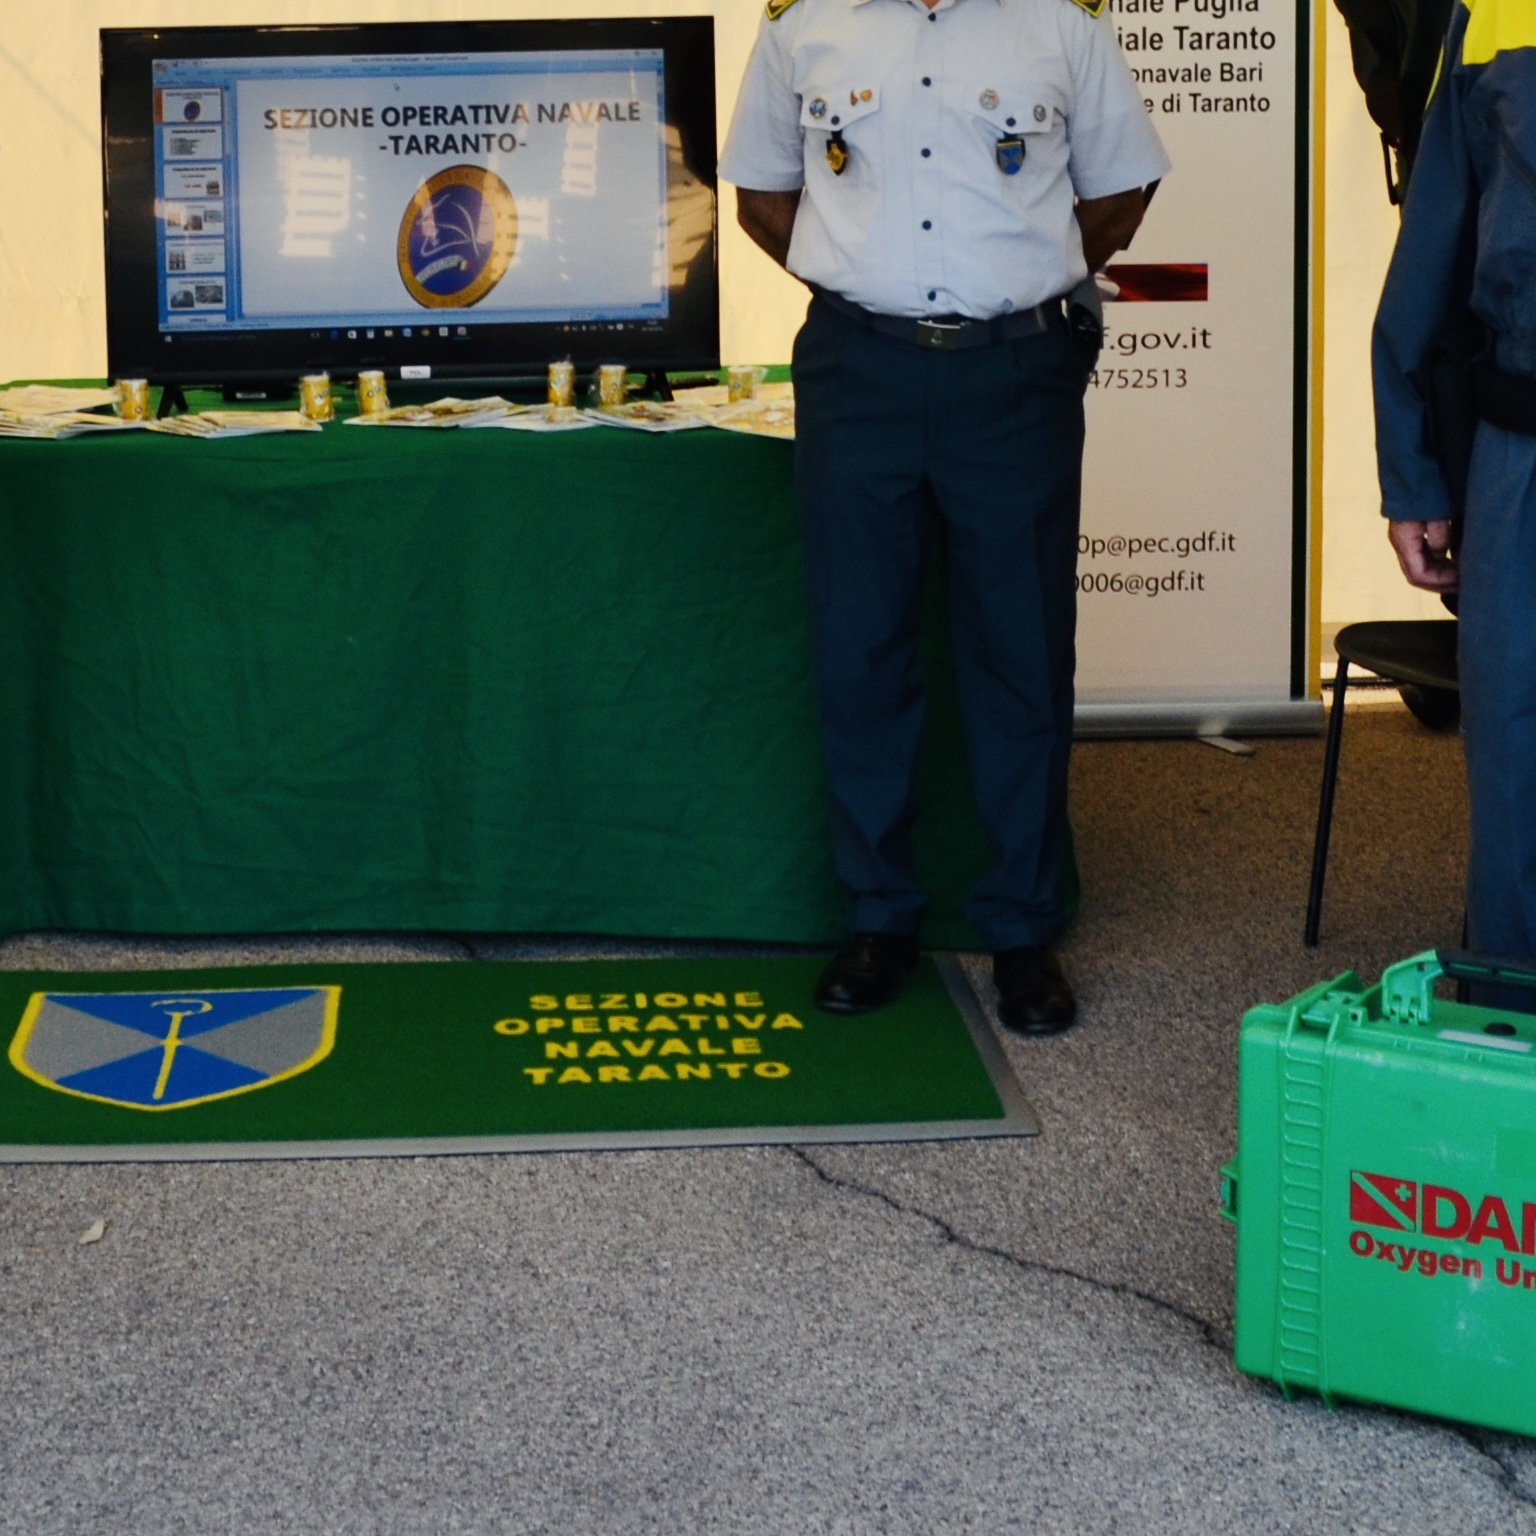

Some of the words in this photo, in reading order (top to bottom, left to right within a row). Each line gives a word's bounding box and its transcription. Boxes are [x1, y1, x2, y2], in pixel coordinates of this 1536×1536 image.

[1173, 25, 1277, 52] Taranto
[1131, 63, 1212, 84] onavale
[1219, 61, 1264, 83] Bari
[263, 105, 375, 129] SEZIONE
[381, 103, 530, 127] OPERATIVA
[537, 100, 642, 124] NAVALE
[1161, 93, 1181, 113] di
[1188, 92, 1271, 113] Taranto
[379, 132, 527, 156] -TARANTO-
[1100, 326, 1212, 356] f.gov.it
[1077, 530, 1236, 559] 0p@pec.gdf.it
[1075, 569, 1206, 597] 006@gdf.it
[529, 991, 764, 1011] SEZIONE
[494, 1013, 804, 1035] OPERATIVA
[545, 1037, 762, 1059] NAVALE
[523, 1061, 791, 1085] TARANTO
[1348, 1229, 1483, 1280] Oxygen
